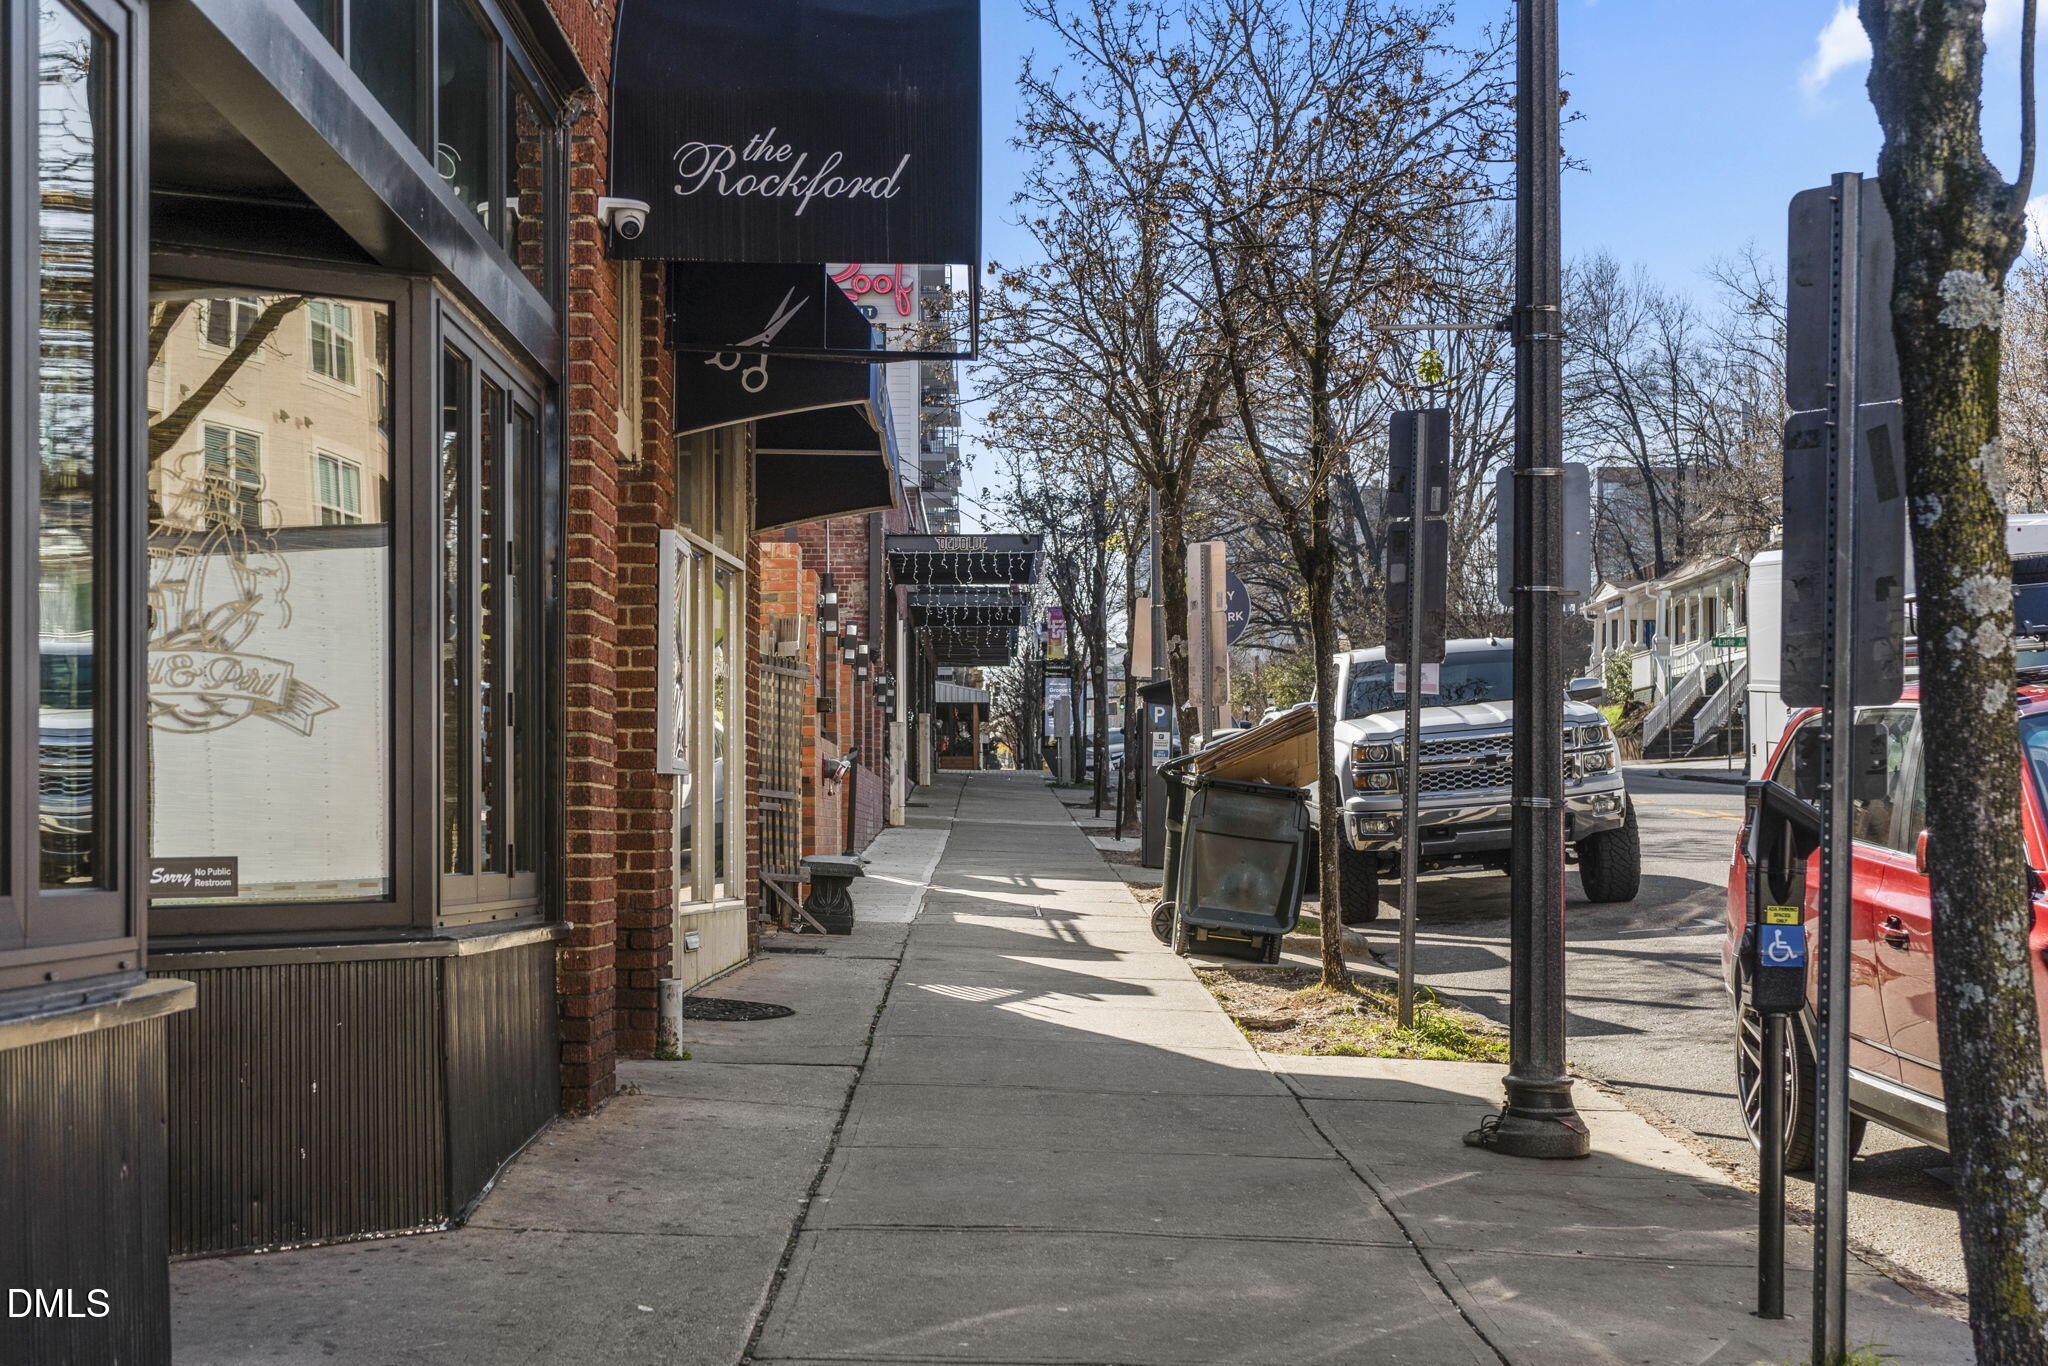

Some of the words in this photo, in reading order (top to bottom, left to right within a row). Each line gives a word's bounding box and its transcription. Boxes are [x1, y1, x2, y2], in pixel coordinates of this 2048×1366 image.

[742, 126, 793, 162] the
[673, 141, 911, 217] Rockford
[1227, 610, 1244, 622] RK
[1718, 638, 1736, 646] Lane
[200, 656, 281, 697] Peril
[1154, 706, 1166, 724] P
[149, 867, 192, 888] Sorry
[194, 867, 206, 876] No
[207, 867, 232, 876] Public
[194, 878, 232, 887] Restroom
